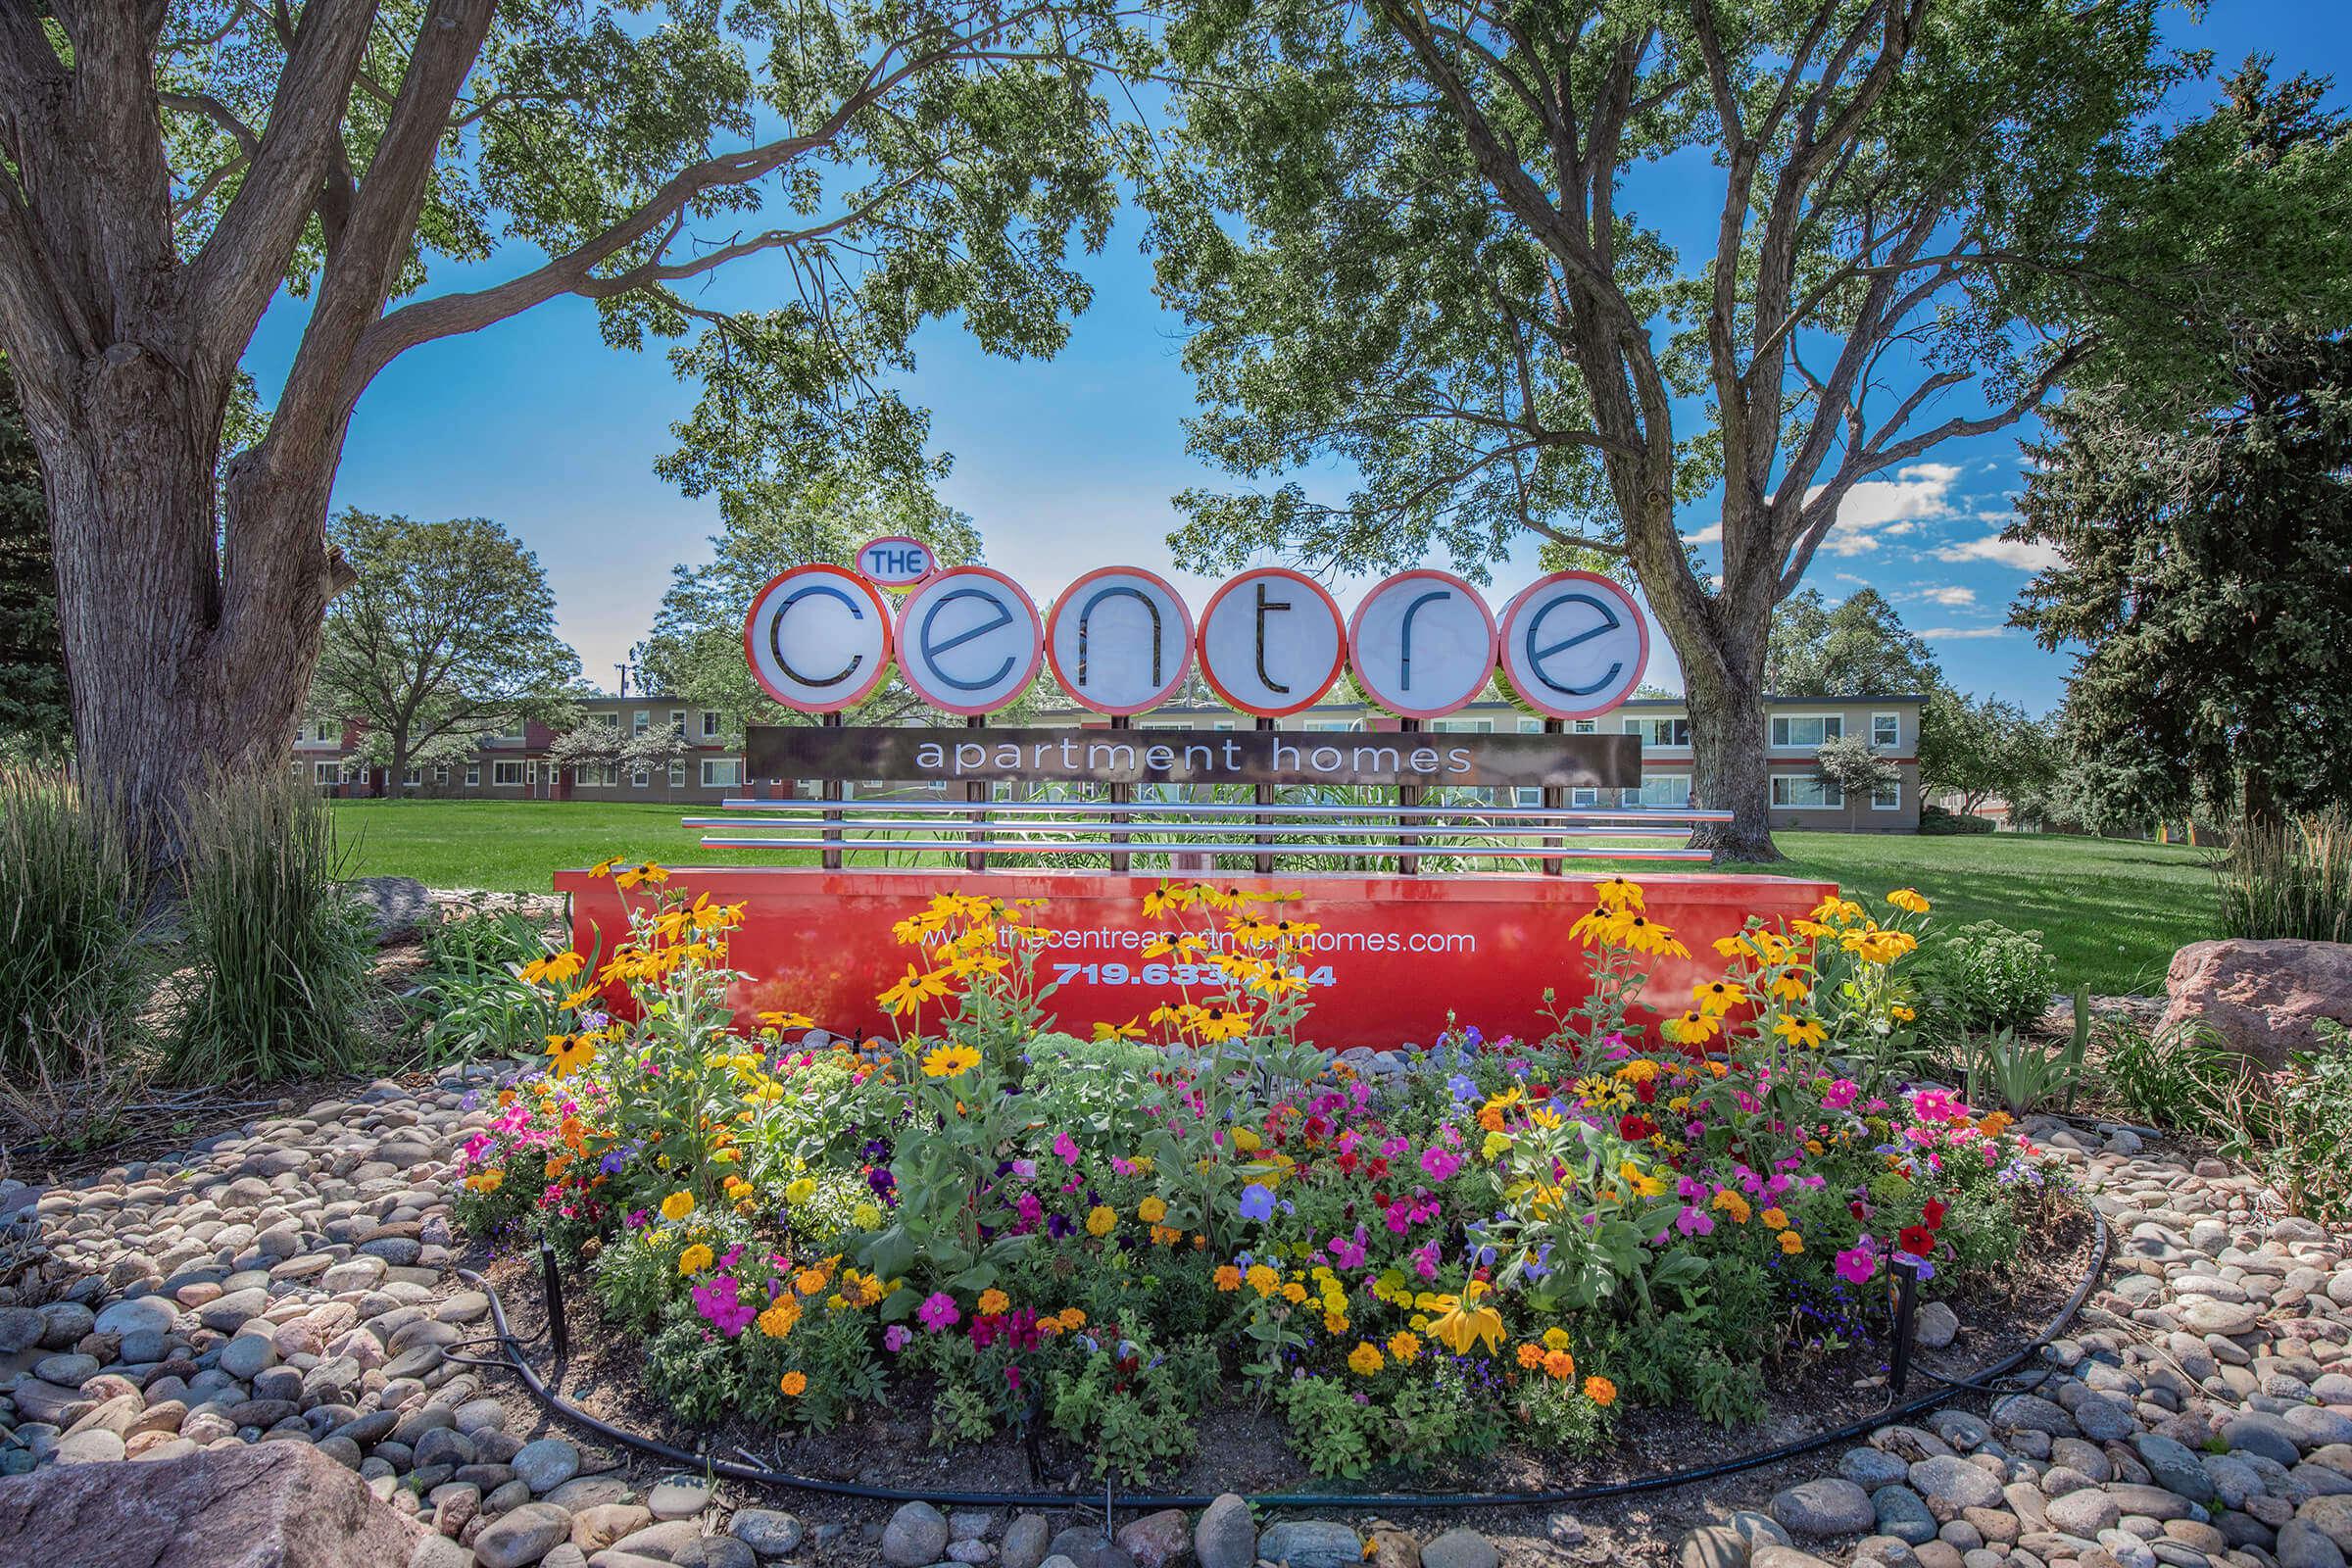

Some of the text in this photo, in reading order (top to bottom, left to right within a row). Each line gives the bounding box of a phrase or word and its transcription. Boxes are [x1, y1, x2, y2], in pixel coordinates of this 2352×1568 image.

[868, 550, 922, 574] THE
[770, 582, 1622, 697] centre
[915, 738, 1472, 774] apartment homes
[916, 925, 1476, 953] ww.thecentreartmhomes.com
[1052, 962, 1337, 987] 719.633.14
